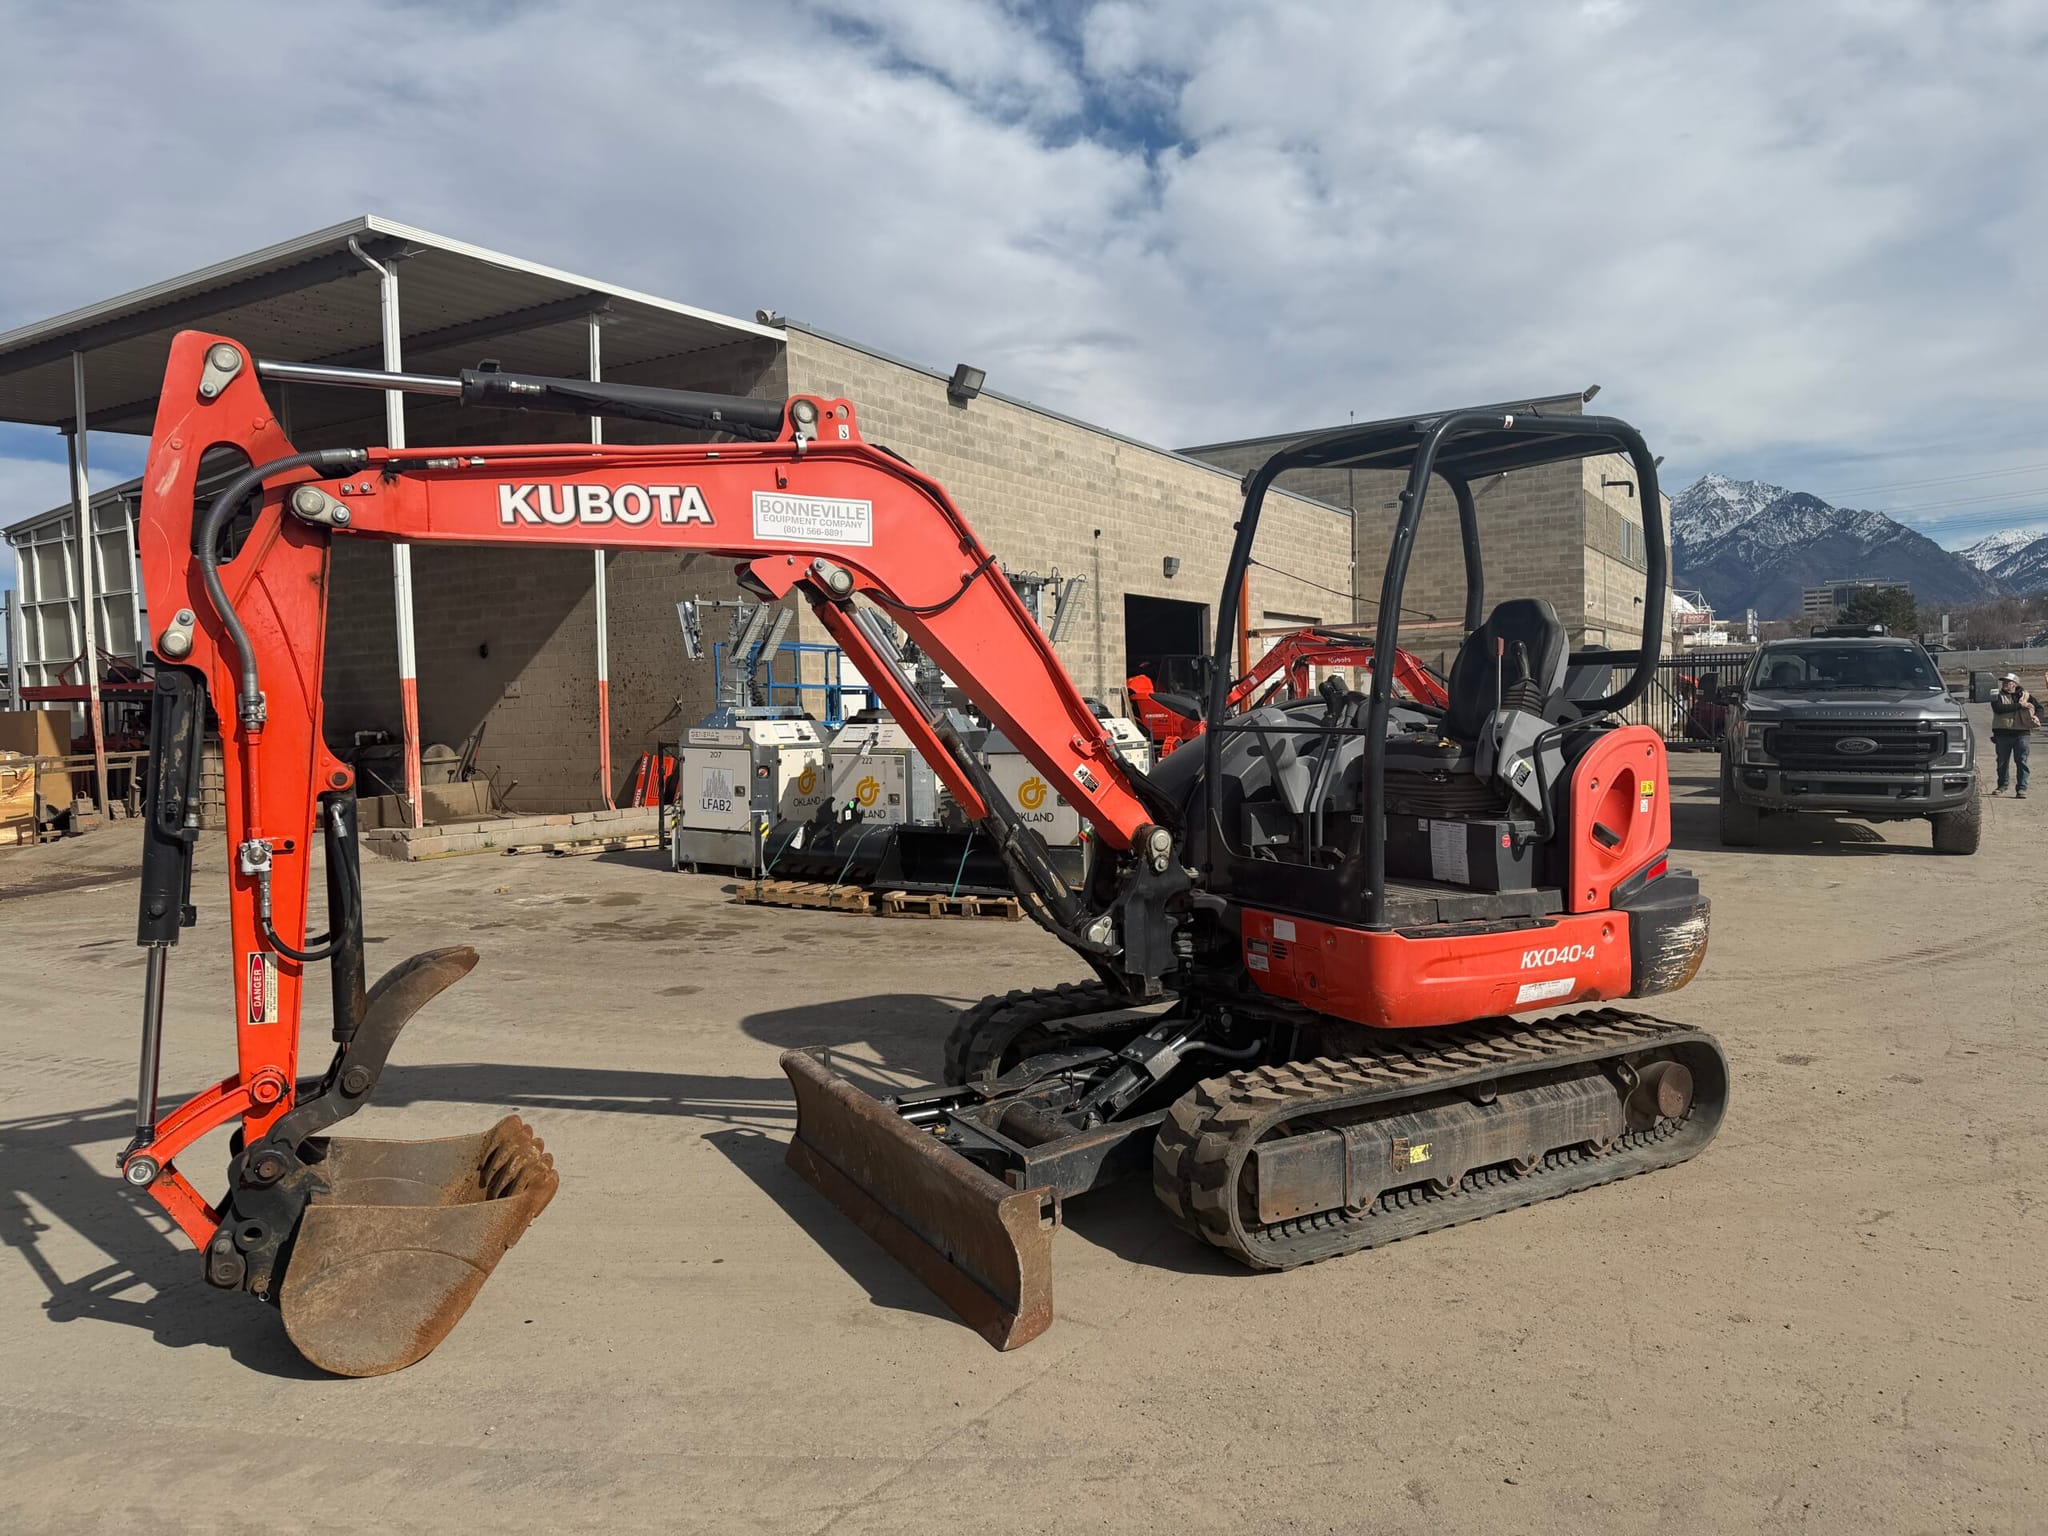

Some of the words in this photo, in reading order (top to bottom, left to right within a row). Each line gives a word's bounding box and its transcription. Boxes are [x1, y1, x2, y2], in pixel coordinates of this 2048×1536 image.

[499, 484, 712, 524] KUBOTA
[760, 499, 866, 520] BONNEVILLE
[763, 513, 818, 527] EQUIPMENT
[819, 518, 863, 528] COMPANY
[862, 757, 873, 765] 222
[702, 797, 732, 812] LFAB2
[792, 796, 821, 807] OKLAND
[863, 809, 886, 819] LAND
[1520, 944, 1596, 969] KX040-4
[253, 969, 262, 1007] DANGER
